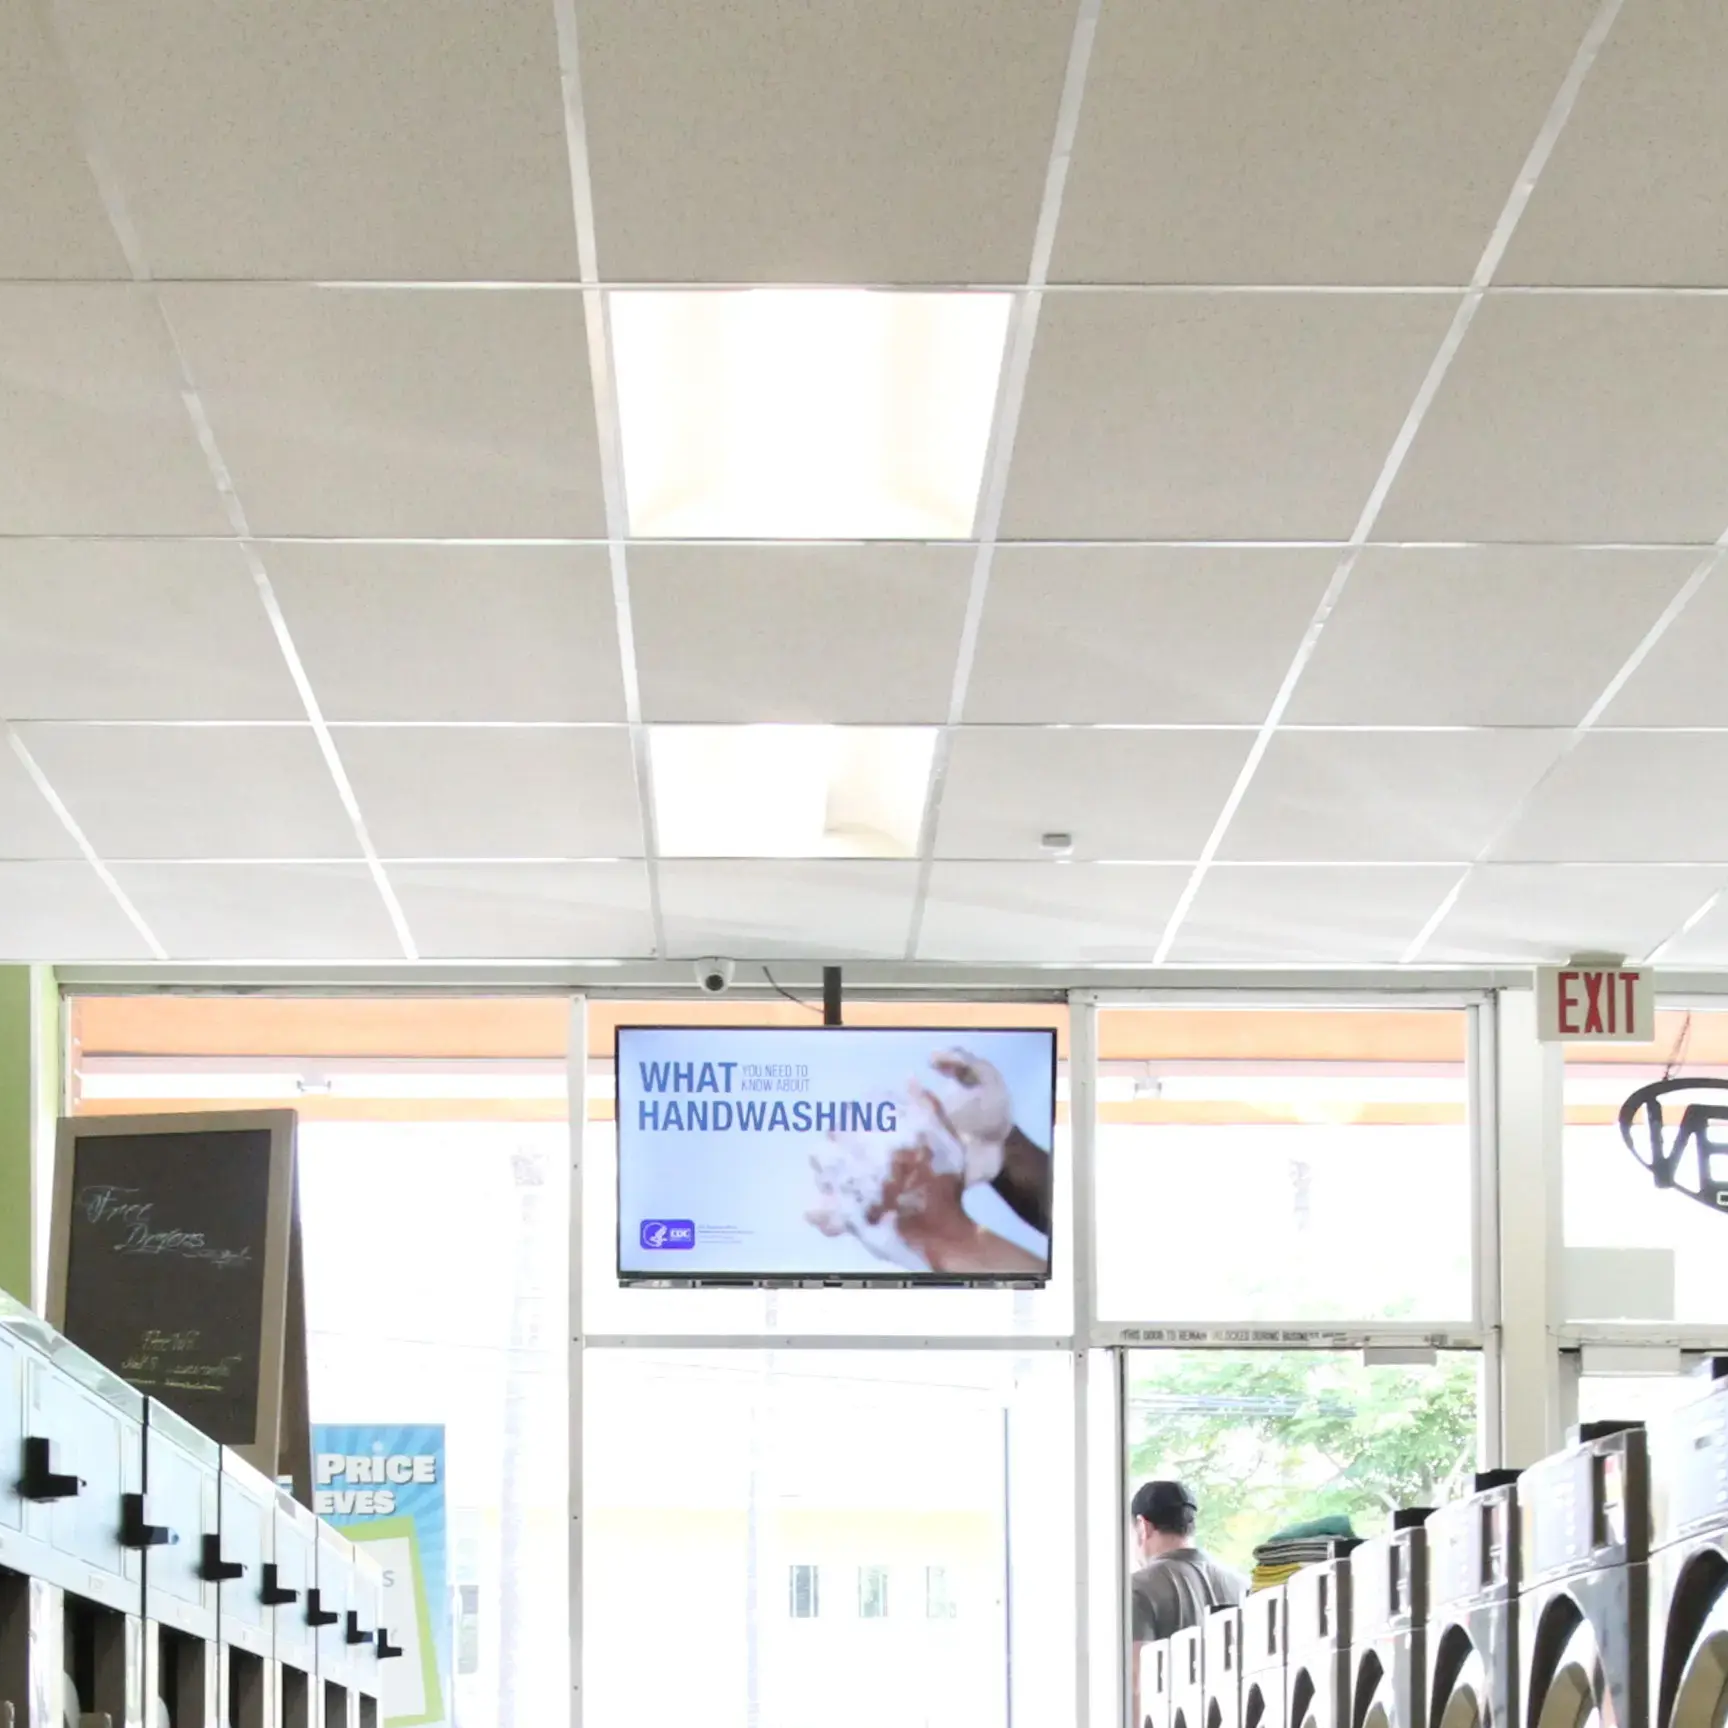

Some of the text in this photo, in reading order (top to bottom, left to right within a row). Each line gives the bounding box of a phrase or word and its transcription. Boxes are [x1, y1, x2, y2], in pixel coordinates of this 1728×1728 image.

[1557, 970, 1640, 1035] EXIT
[639, 1061, 738, 1093] WHAT
[741, 1064, 809, 1078] YOU NEED TO
[741, 1078, 811, 1093] KNOW ABOUT
[638, 1100, 897, 1132] HANDWASHING
[82, 1184, 156, 1223] Free
[316, 1453, 437, 1486] PRICE
[313, 1490, 396, 1516] EVES
